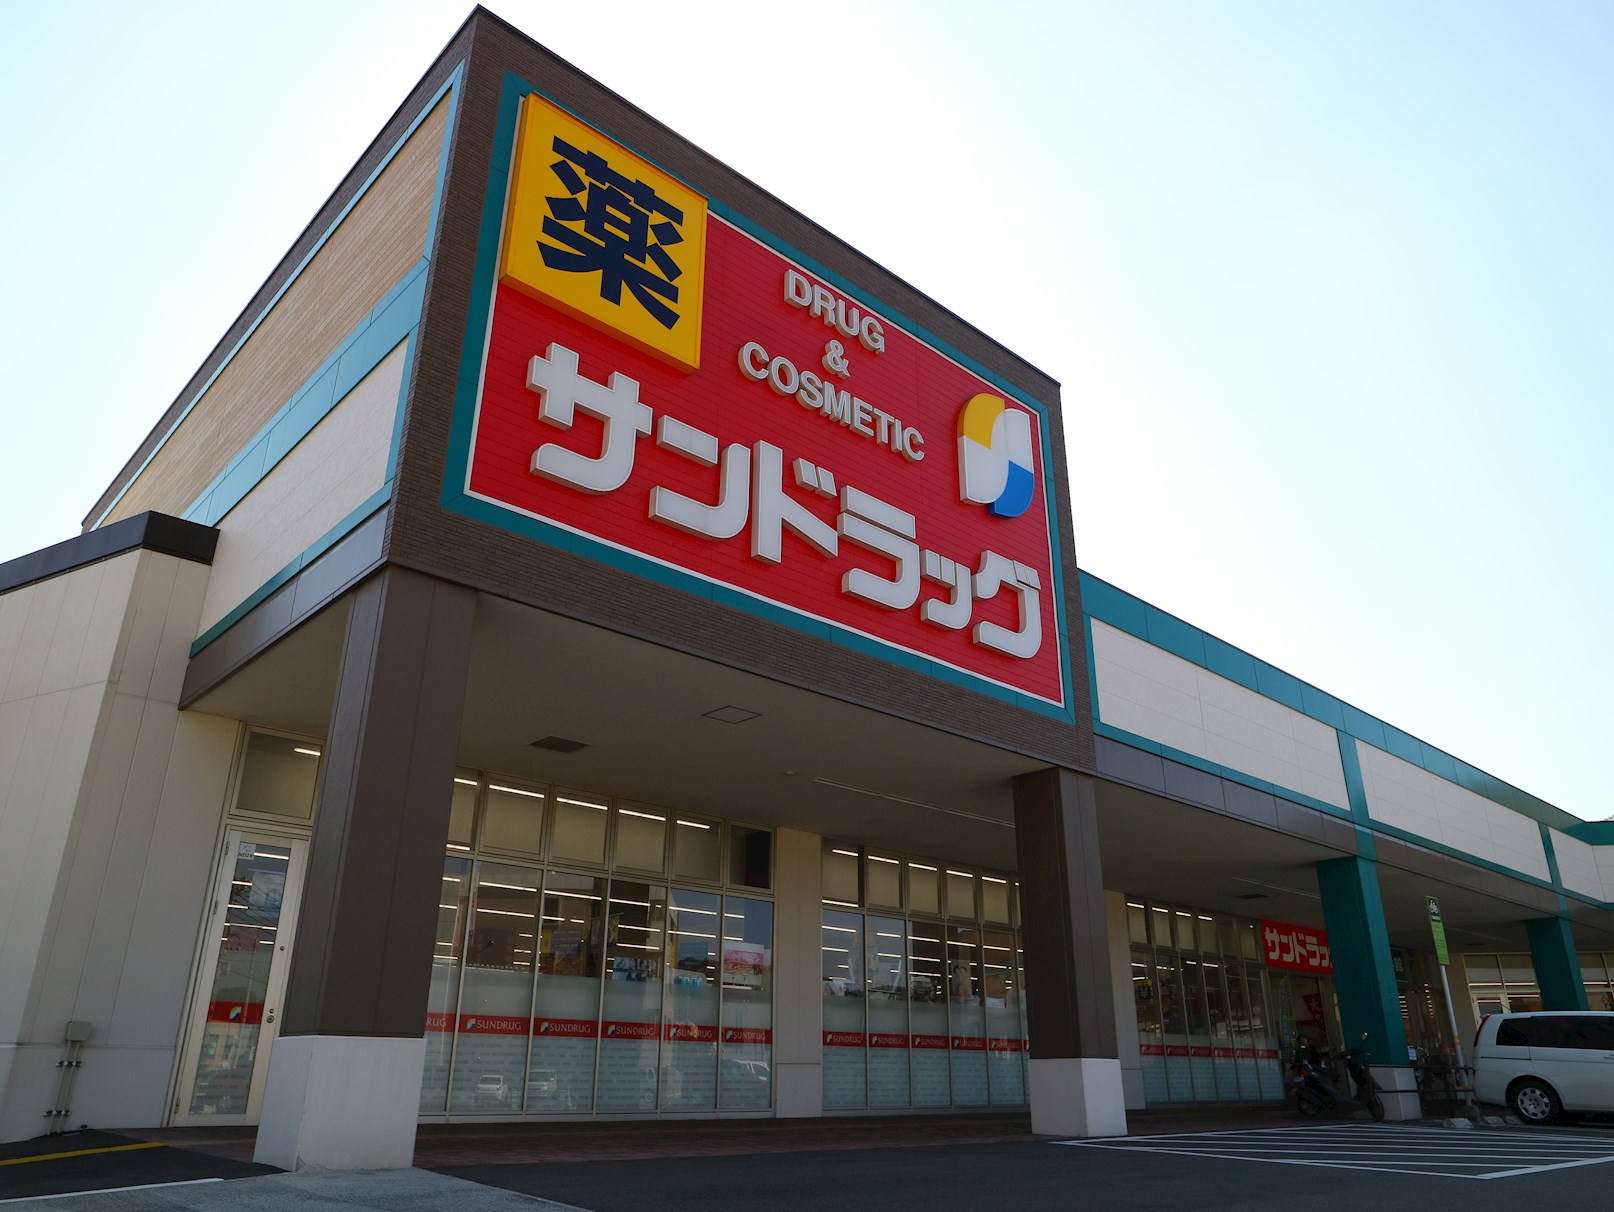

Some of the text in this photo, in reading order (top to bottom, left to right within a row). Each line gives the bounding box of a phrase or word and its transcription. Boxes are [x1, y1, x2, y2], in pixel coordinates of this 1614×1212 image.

[536, 135, 684, 330] 薬
[784, 269, 886, 353] DRUG
[823, 339, 851, 378] &
[738, 341, 925, 461] COSMETIC
[526, 342, 1042, 659] サンドラッグ
[1264, 927, 1333, 969] サンドラッ
[477, 1019, 522, 1031] SUNDRUG
[549, 1022, 591, 1033] SUNDRUG
[616, 1025, 654, 1036] SUNDRUG
[677, 1028, 713, 1038] SUNDRUG
[733, 1030, 766, 1040] SUNDRUG
[832, 1034, 861, 1043] SUNDRUG
